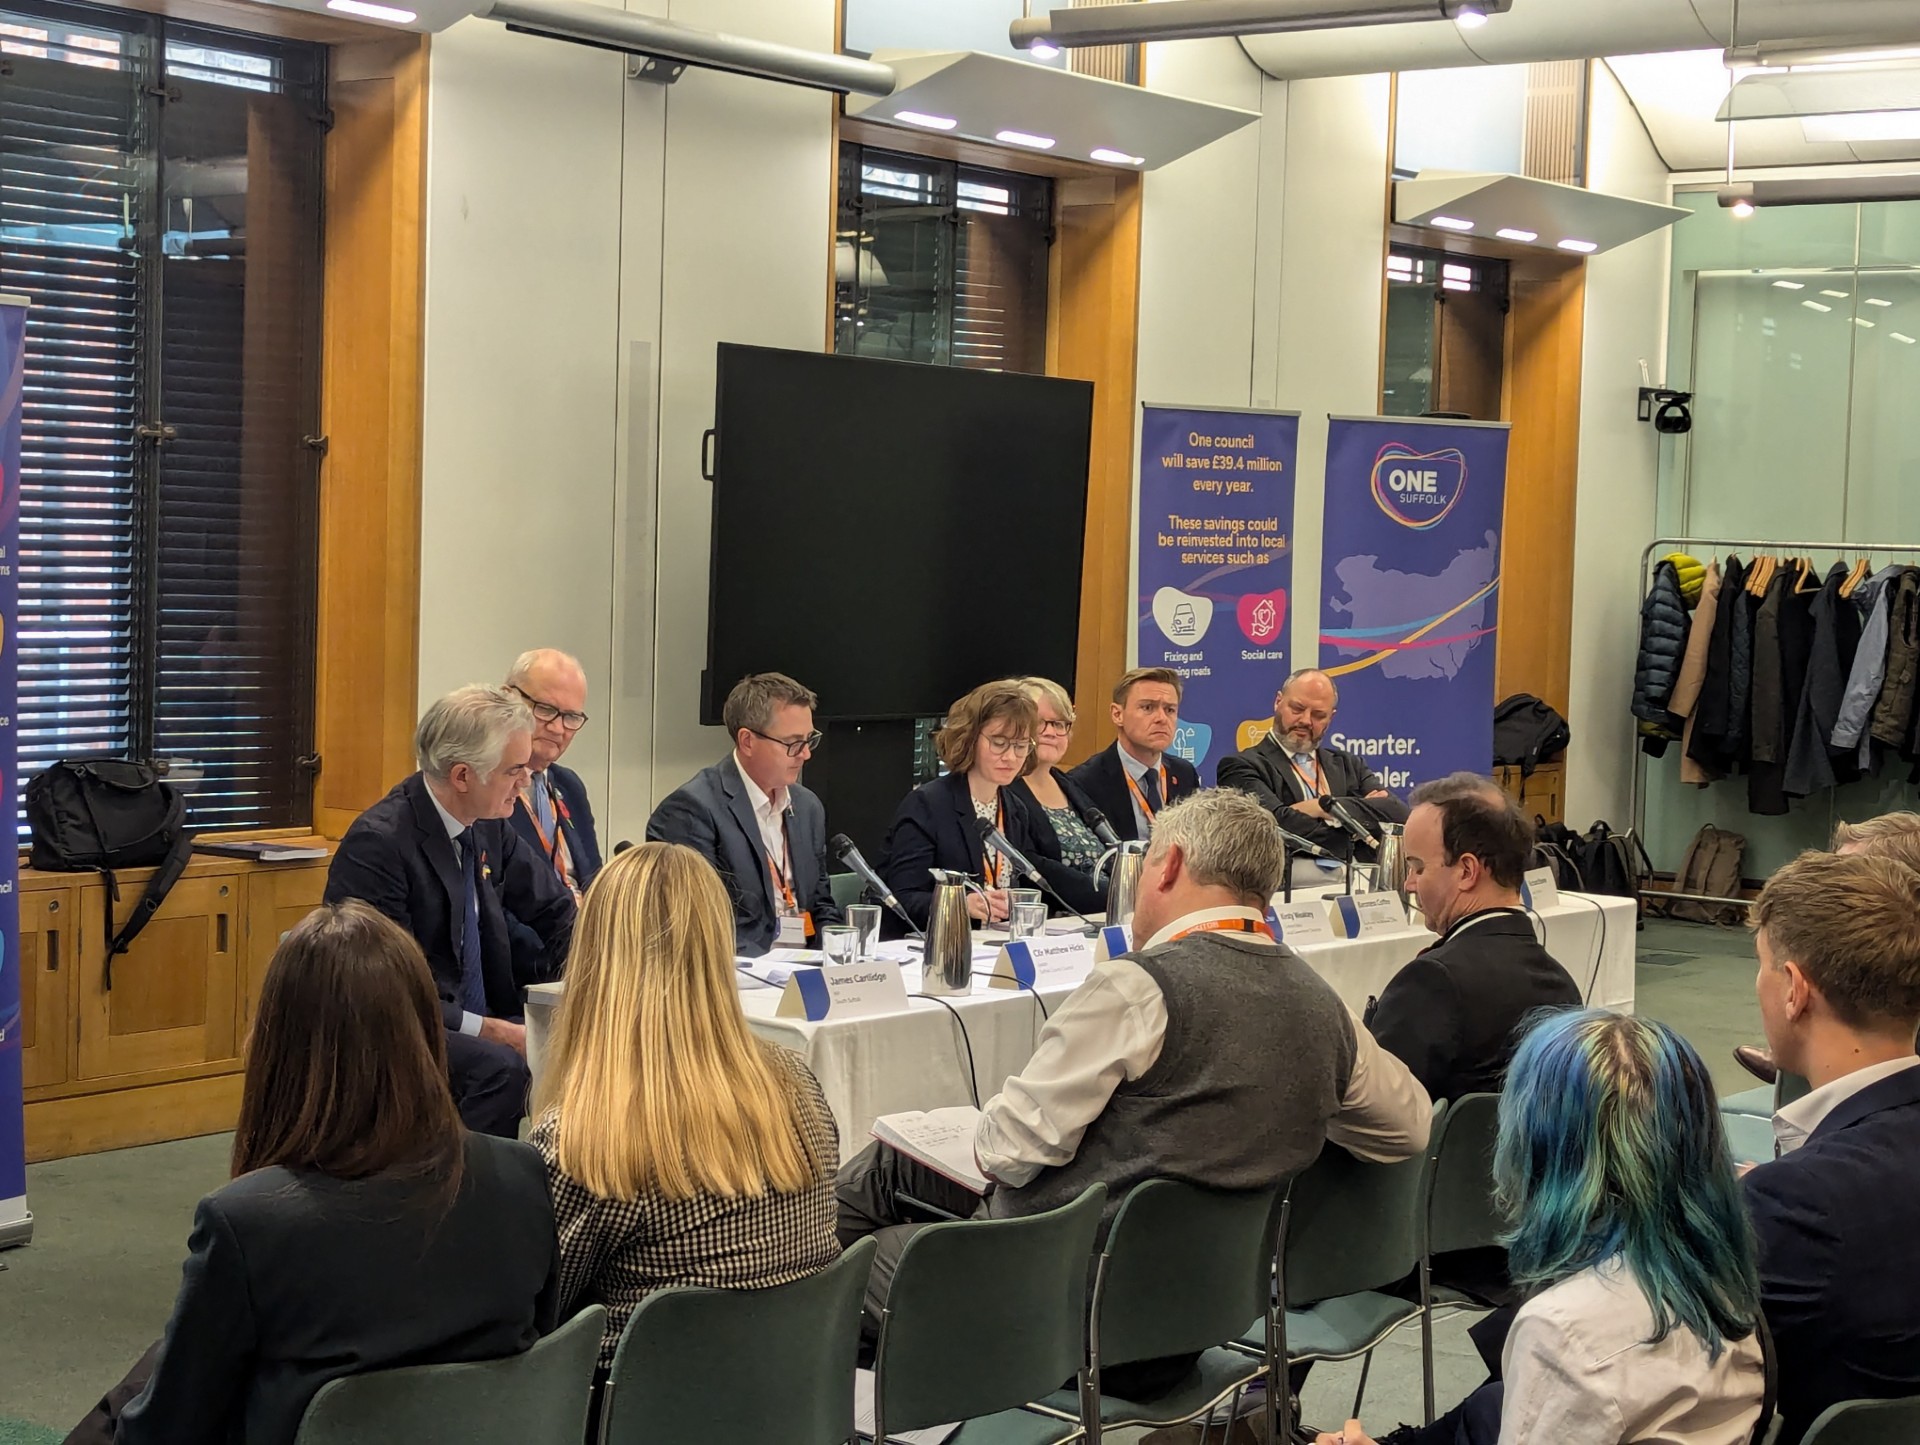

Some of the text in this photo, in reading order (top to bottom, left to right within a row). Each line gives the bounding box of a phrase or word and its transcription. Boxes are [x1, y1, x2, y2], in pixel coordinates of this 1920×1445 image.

[1189, 432, 1254, 449] One council
[1162, 453, 1282, 471] will save £39.4 million
[1193, 479, 1254, 495] every year.
[1388, 469, 1438, 493] ONE
[1399, 493, 1447, 505] SUFFOLK
[1168, 514, 1278, 534] These savings could
[1158, 532, 1286, 549] be reinvested into local
[1181, 549, 1270, 565] services such as
[1164, 651, 1203, 664] Fixing and
[1241, 649, 1283, 660] Social care
[1190, 665, 1211, 676] roads
[1330, 733, 1421, 756] Smarter.
[830, 976, 854, 986] James
